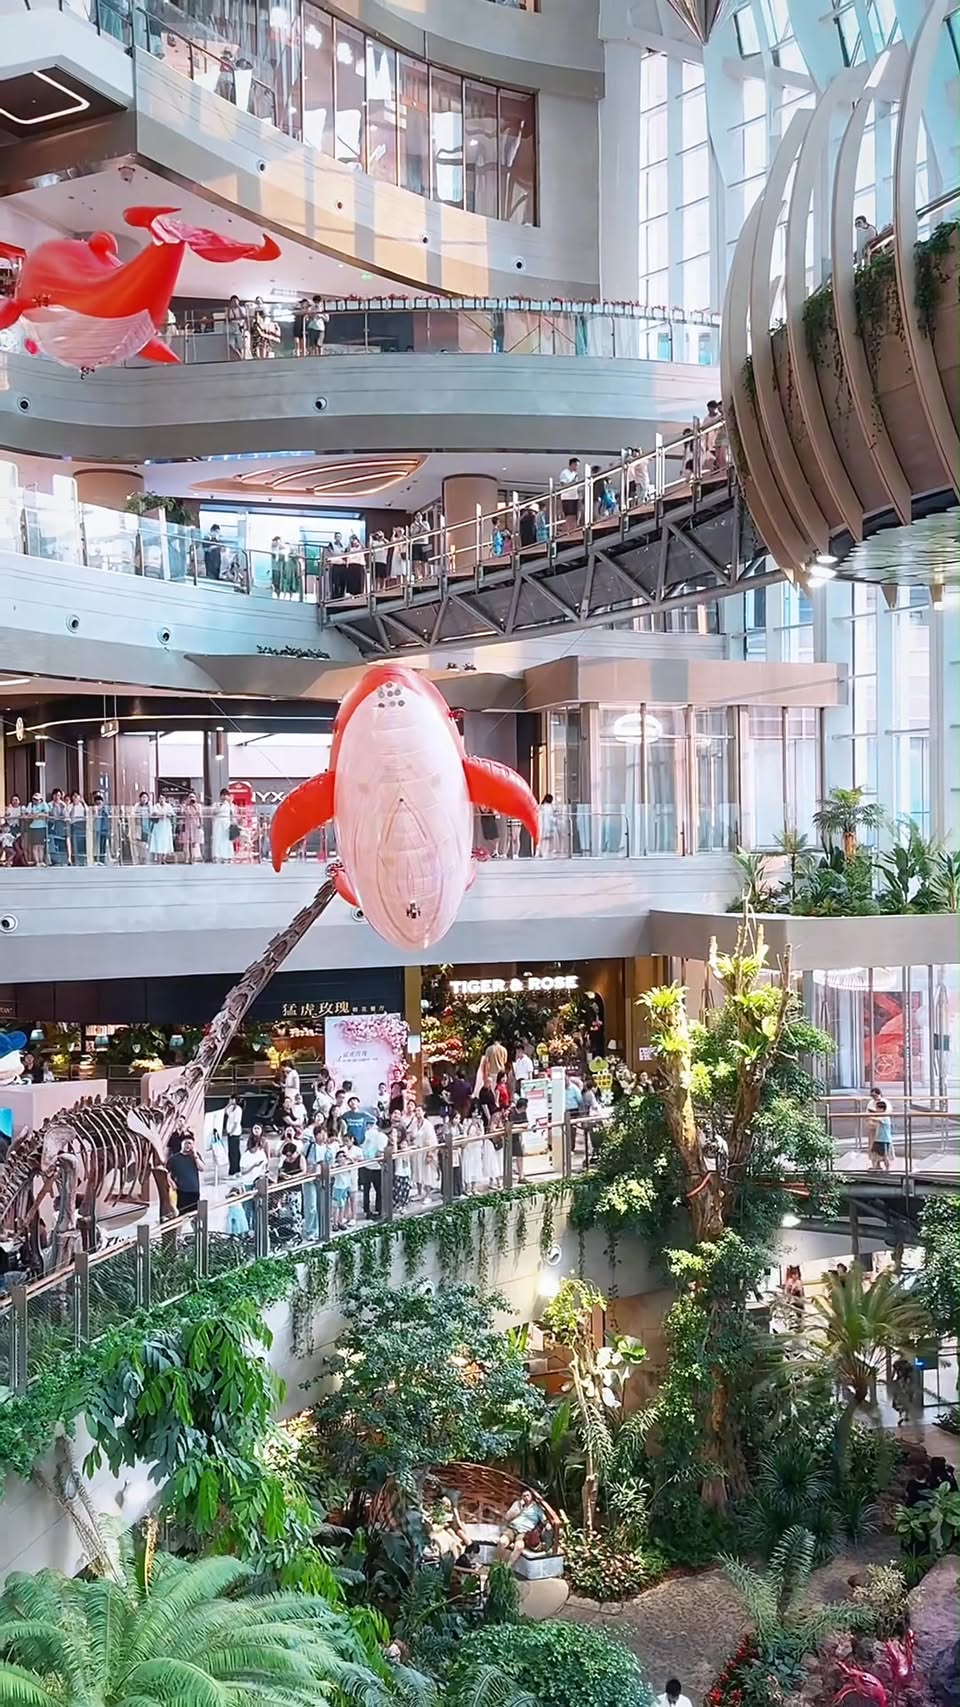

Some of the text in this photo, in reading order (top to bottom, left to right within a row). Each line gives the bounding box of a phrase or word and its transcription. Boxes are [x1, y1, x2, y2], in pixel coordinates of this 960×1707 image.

[449, 975, 580, 995] TIGER & ROSE
[281, 1001, 350, 1018] 猛虎玫瑰
